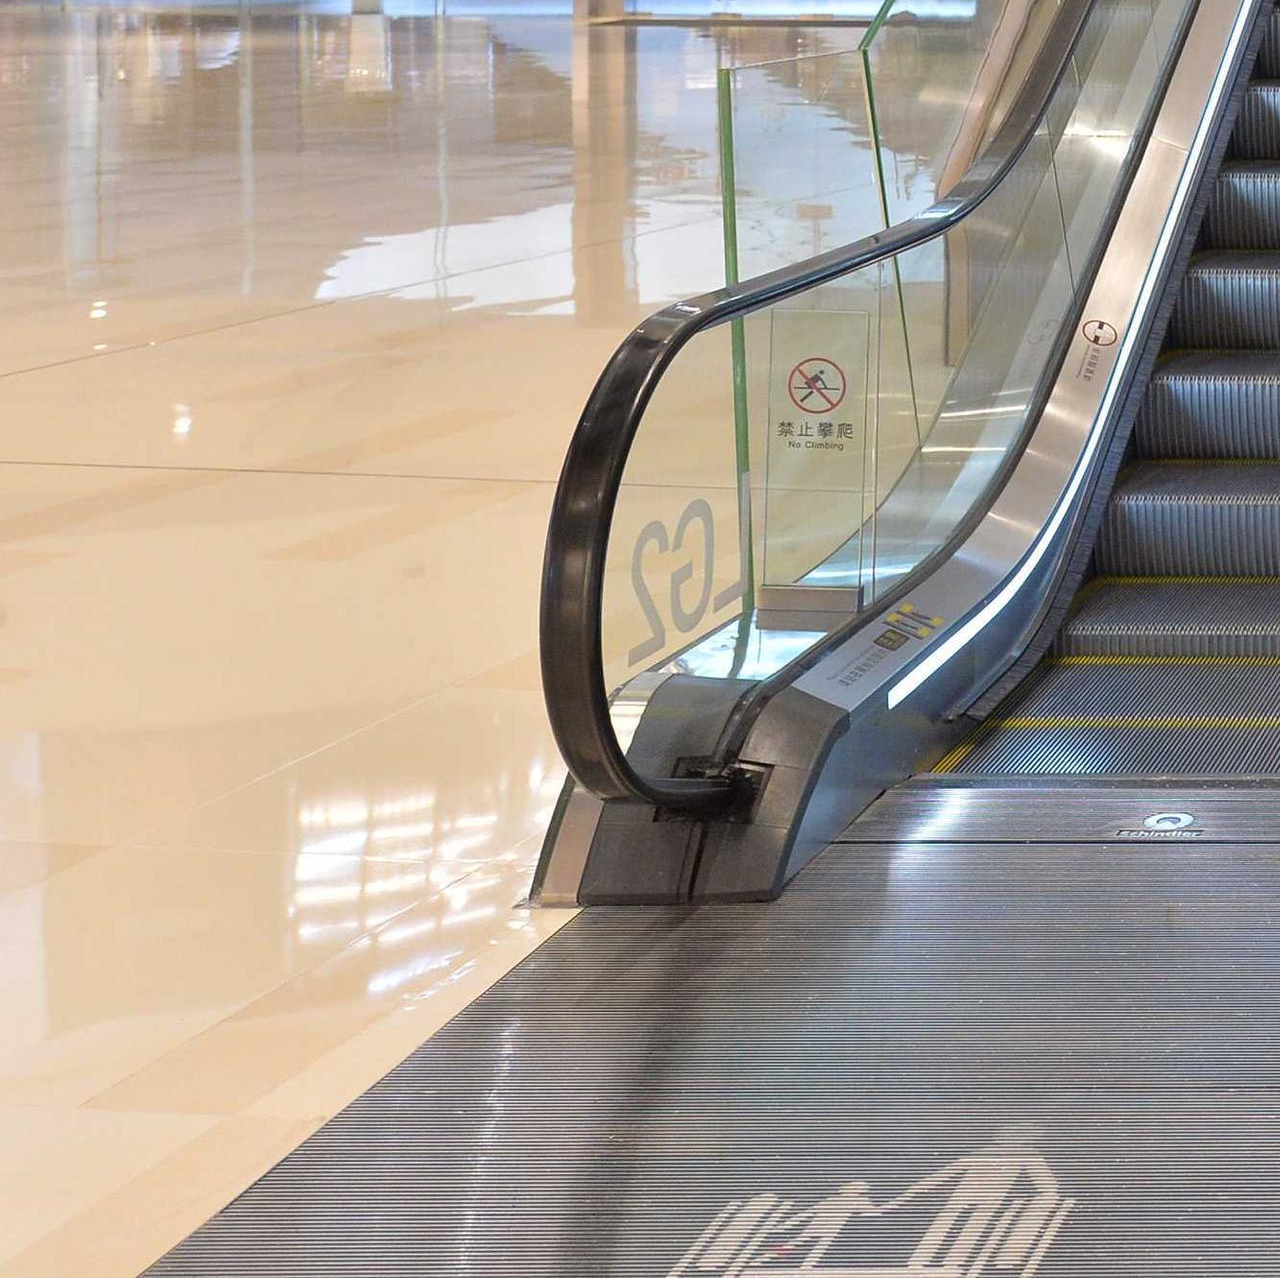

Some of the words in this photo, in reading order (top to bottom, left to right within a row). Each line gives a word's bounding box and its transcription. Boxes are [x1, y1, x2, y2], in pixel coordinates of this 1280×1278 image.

[777, 420, 854, 440] 禁止攀爬
[788, 441, 801, 450] No
[804, 441, 845, 452] Climbing
[1118, 829, 1203, 838] Schindler
